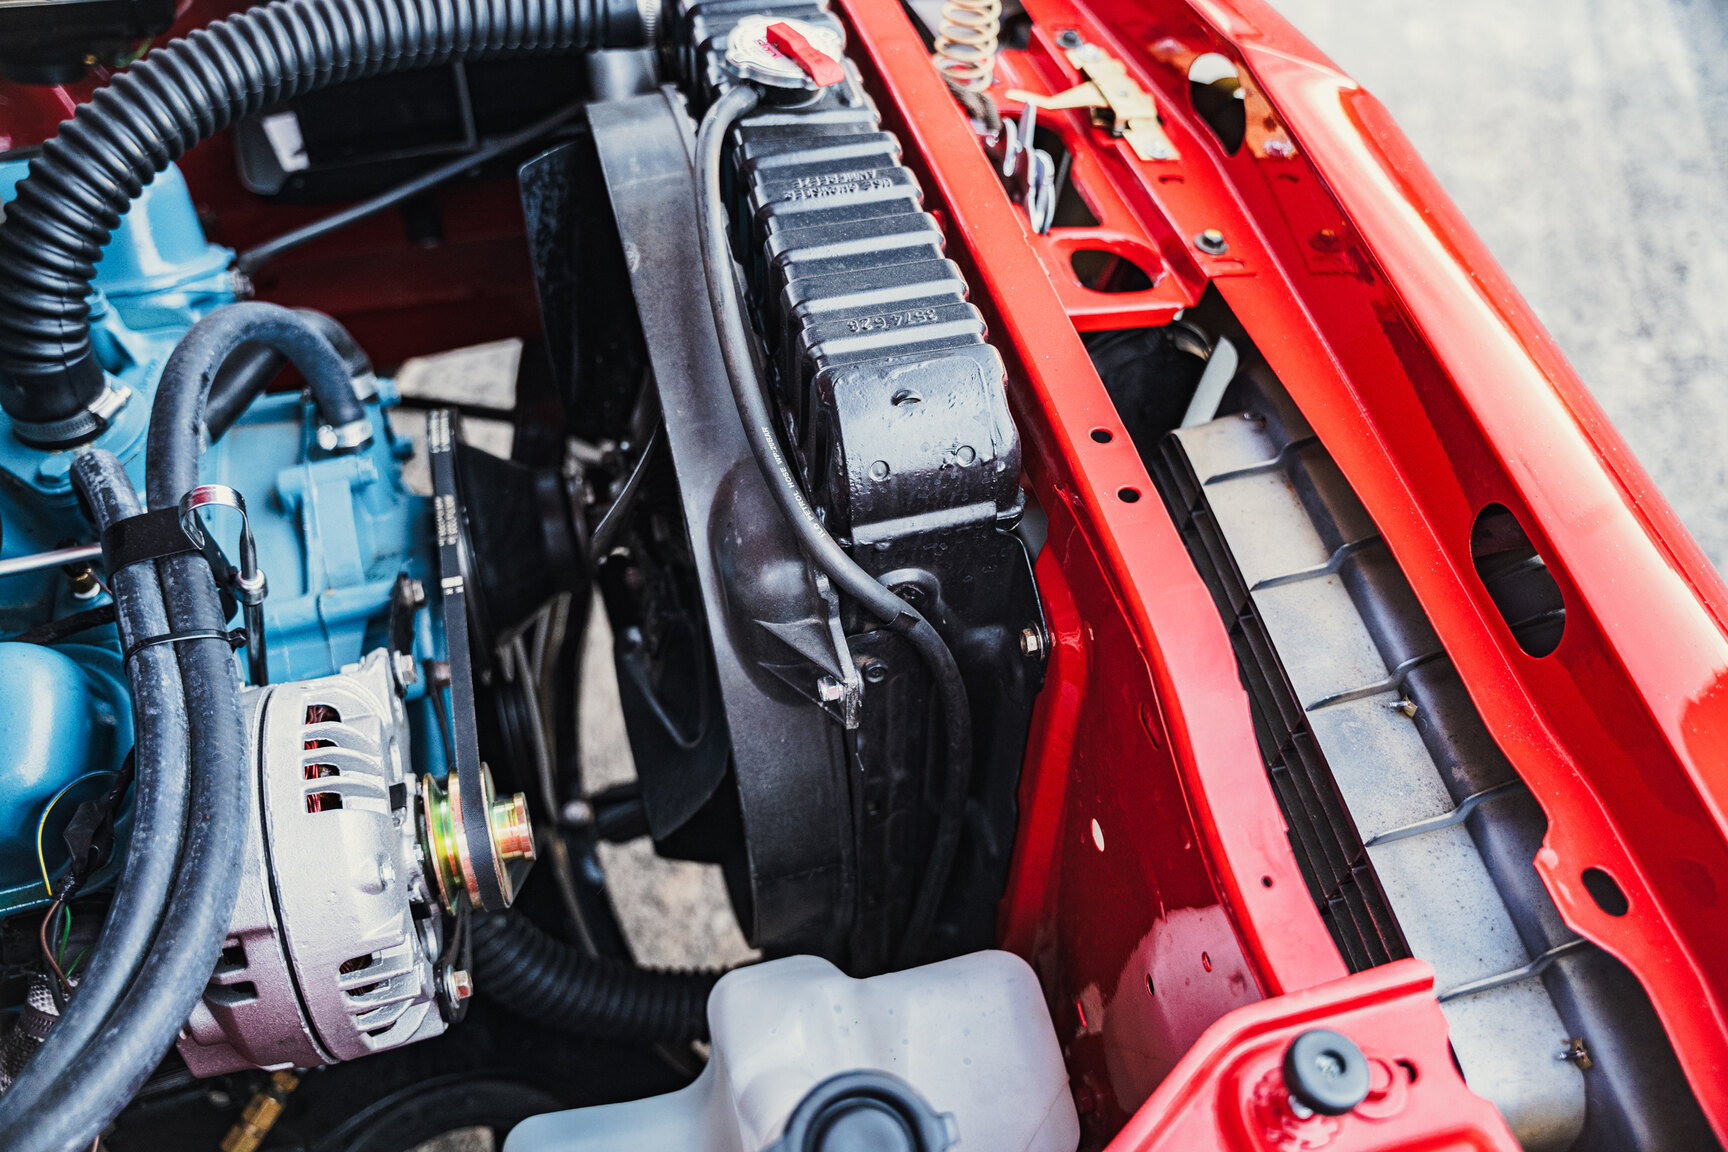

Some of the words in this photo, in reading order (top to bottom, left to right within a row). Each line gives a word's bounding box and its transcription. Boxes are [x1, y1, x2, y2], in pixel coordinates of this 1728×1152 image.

[792, 169, 876, 188] ANTIFREEZE
[862, 178, 892, 191] USE
[780, 467, 794, 488] HOSE
[794, 490, 813, 521] PETROL
